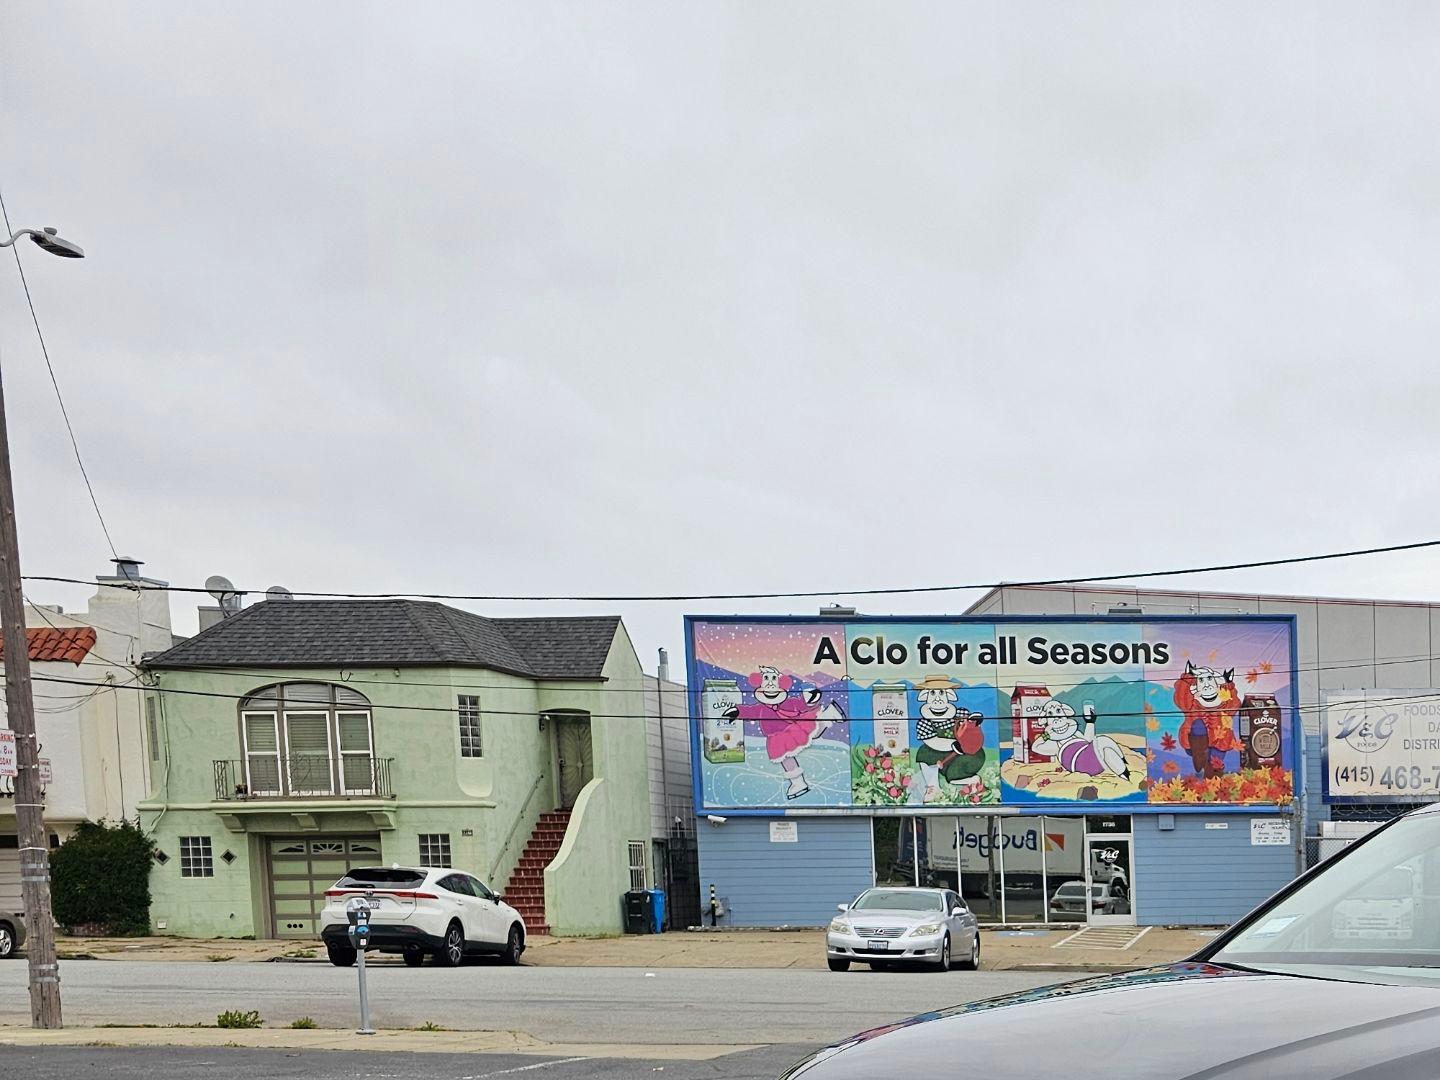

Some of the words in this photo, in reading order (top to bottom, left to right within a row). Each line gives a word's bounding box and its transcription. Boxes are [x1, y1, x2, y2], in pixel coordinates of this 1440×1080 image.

[813, 637, 841, 665] A
[850, 637, 908, 665] Clo
[917, 636, 968, 665] for
[979, 636, 1017, 665] all
[1027, 637, 1170, 665] Seasons
[713, 701, 737, 709] CLOVE
[877, 708, 904, 716] CLOVER
[1253, 716, 1278, 726] CLOVER
[1335, 766, 1375, 787] (415)
